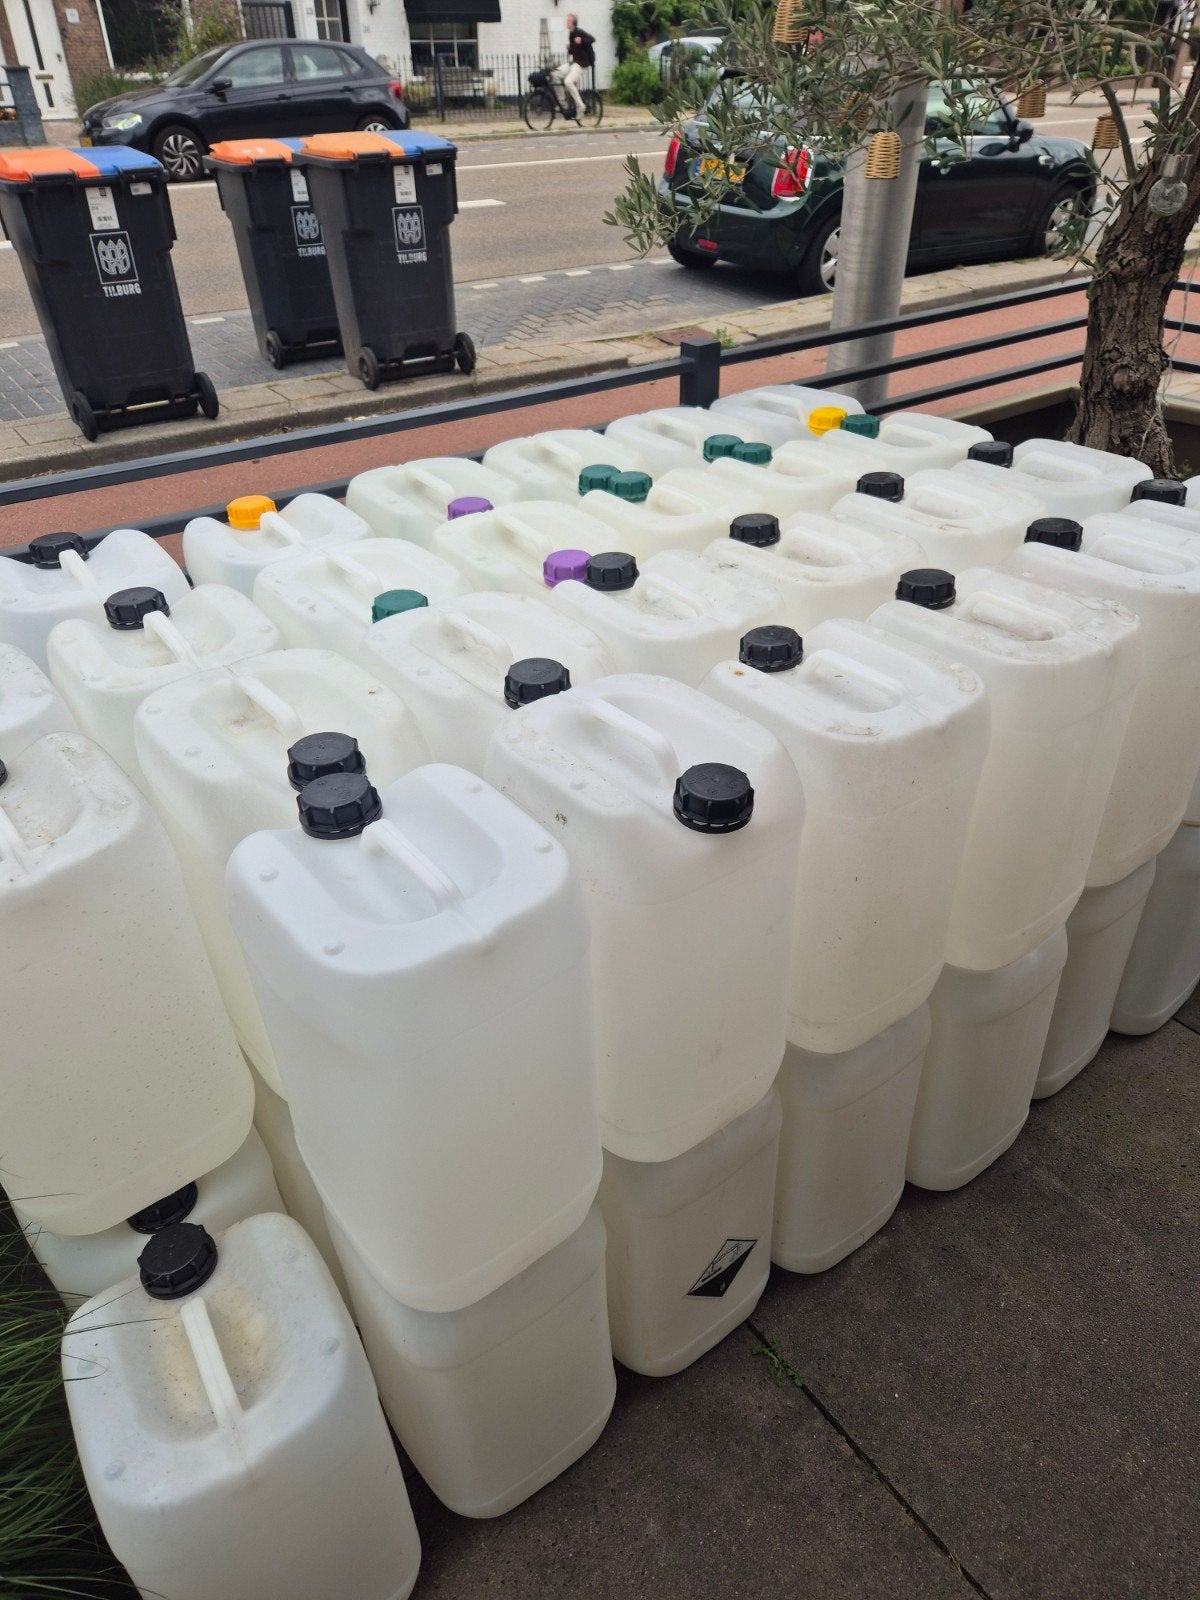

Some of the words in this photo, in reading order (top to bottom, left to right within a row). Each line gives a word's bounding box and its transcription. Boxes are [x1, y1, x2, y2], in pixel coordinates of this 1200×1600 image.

[298, 246, 326, 257] TILBURG
[397, 251, 428, 263] TILBURG
[102, 283, 142, 298] TILBURG
